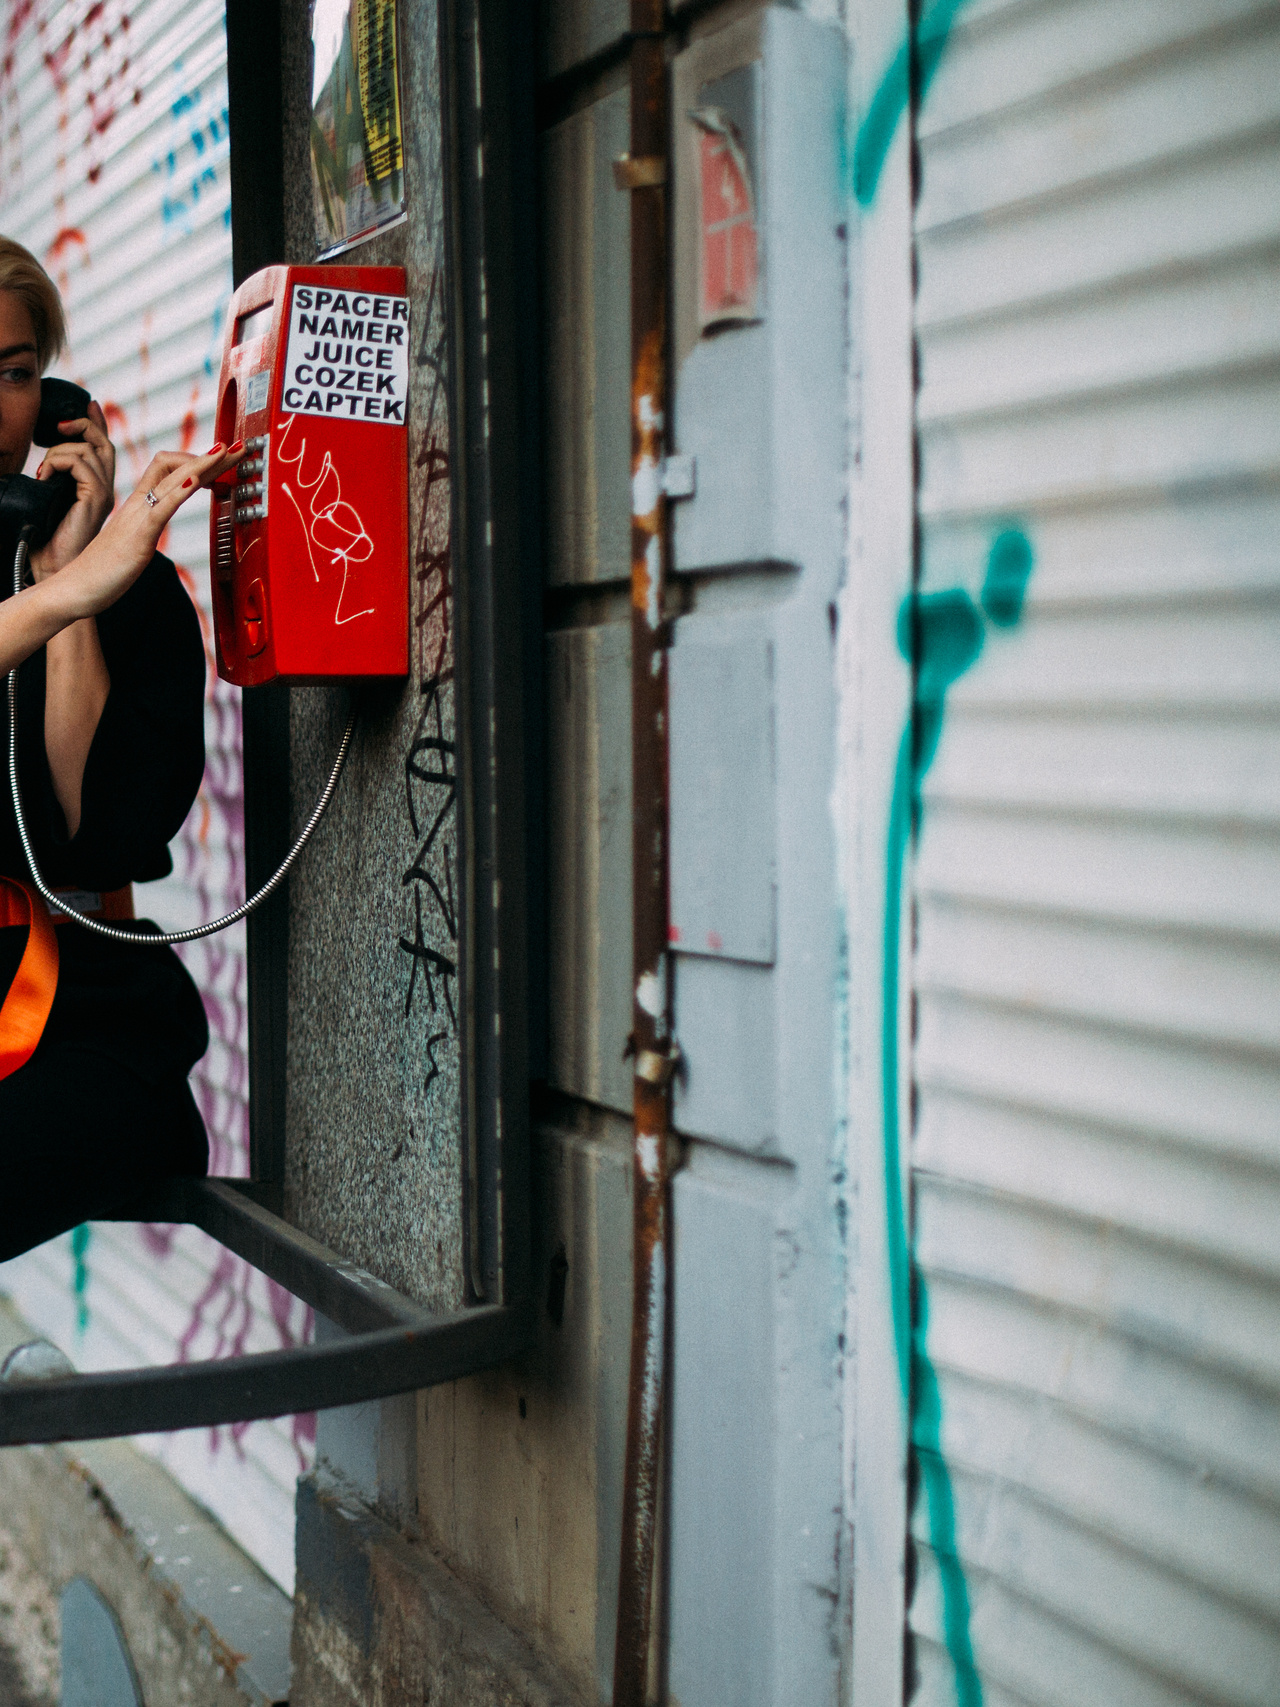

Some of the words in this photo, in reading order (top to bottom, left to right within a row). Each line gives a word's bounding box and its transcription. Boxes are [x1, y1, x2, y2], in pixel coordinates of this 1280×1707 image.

[295, 288, 408, 321] SPACER
[298, 313, 404, 346] NAMER
[303, 341, 394, 370] JUICE
[294, 364, 397, 396] COZEK
[284, 387, 405, 421] CAPTEK
